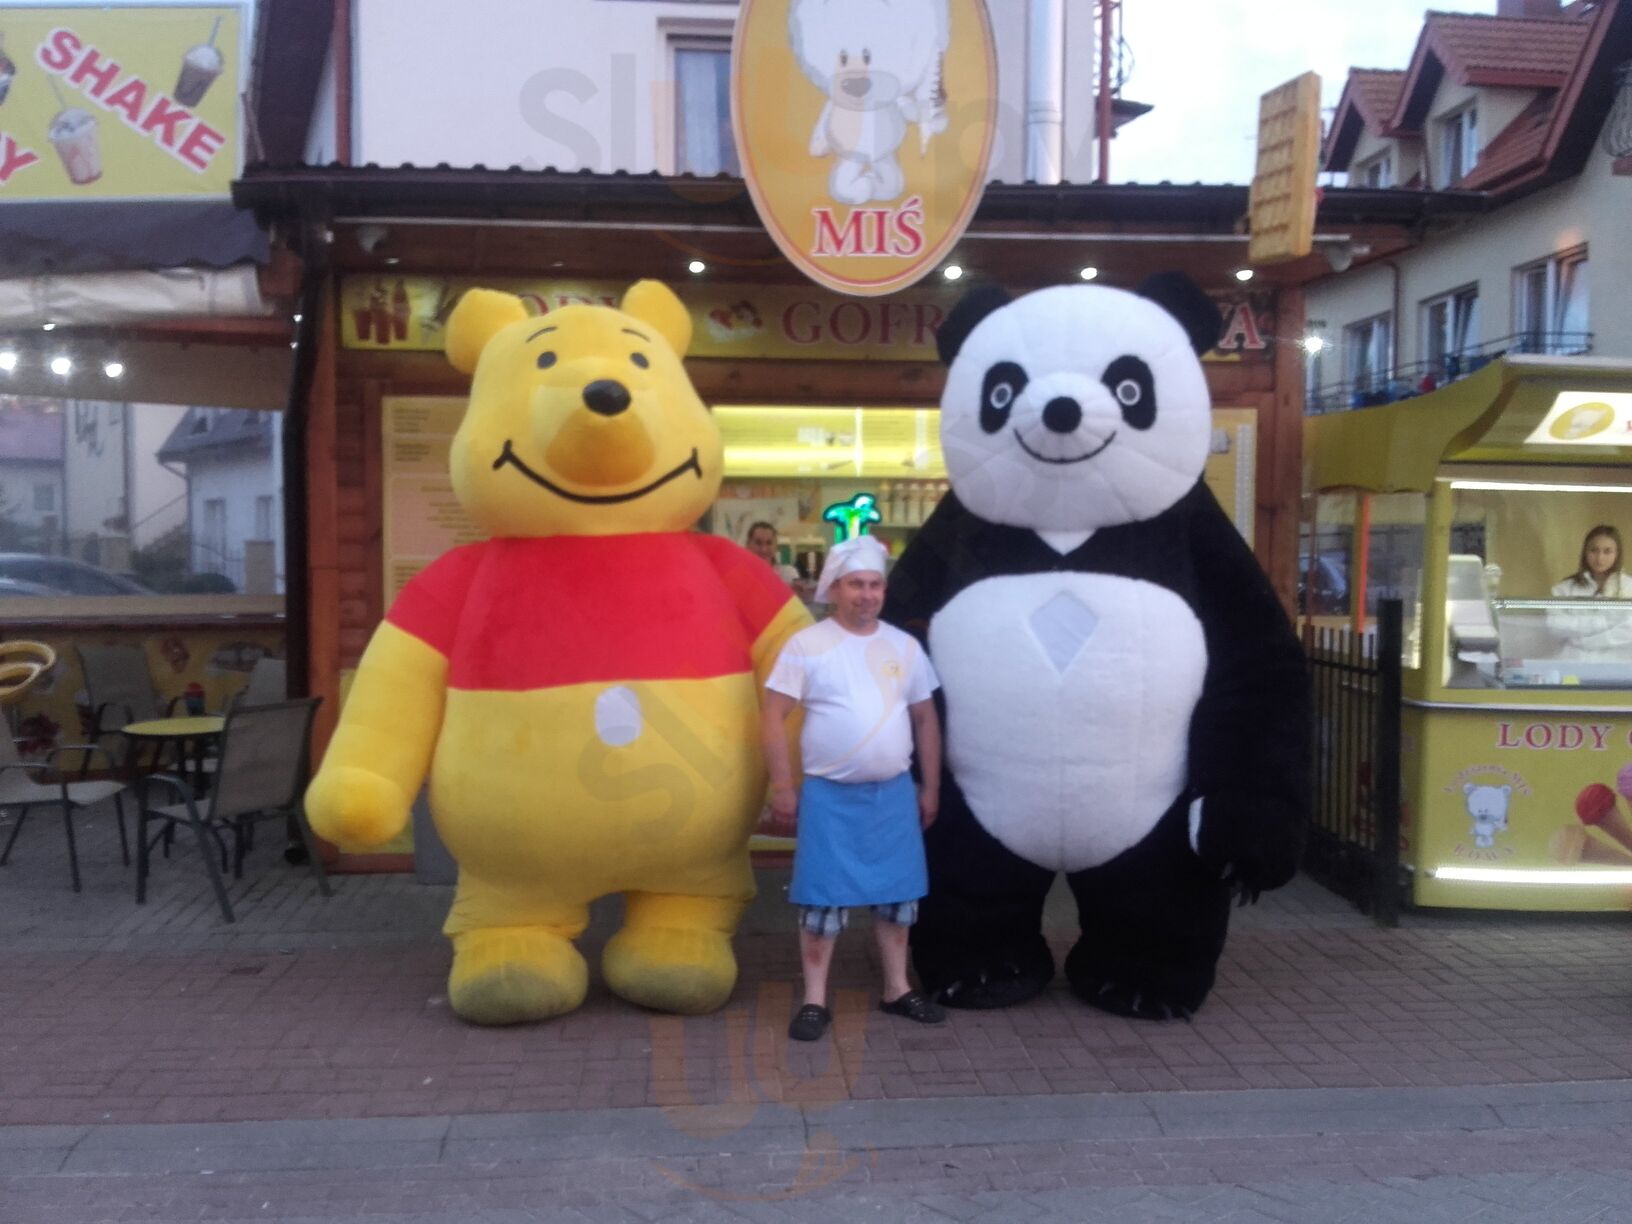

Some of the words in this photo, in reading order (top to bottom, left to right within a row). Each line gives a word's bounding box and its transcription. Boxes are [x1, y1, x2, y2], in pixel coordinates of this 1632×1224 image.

[39, 29, 227, 171] SHAKE
[811, 198, 924, 257] MIŚ
[1497, 723, 1613, 750] LODY
